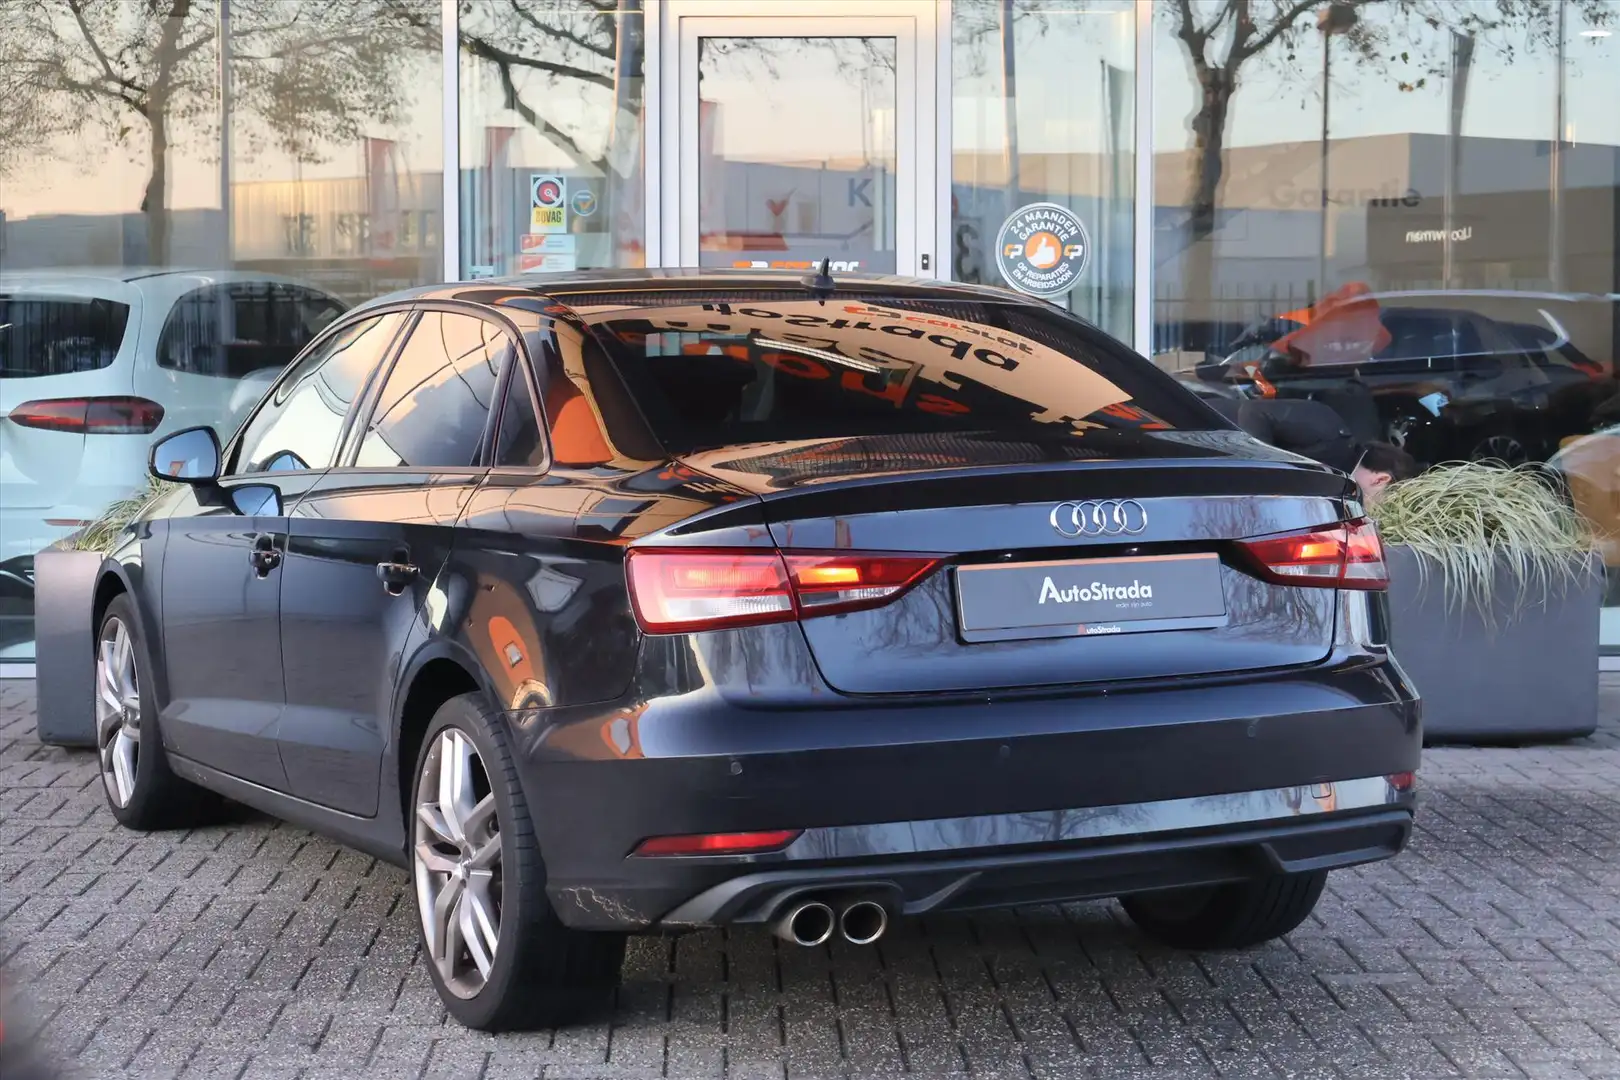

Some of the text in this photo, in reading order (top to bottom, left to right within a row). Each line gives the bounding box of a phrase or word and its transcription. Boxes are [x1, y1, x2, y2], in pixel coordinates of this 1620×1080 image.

[534, 210, 562, 223] BOVAG
[1010, 210, 1078, 236] 24 MAANDEN
[1018, 221, 1070, 242] GARANTIE
[1012, 268, 1074, 289] EN ARBEIDSLOON
[1017, 261, 1070, 281] OP REPARATIES
[1038, 576, 1153, 604] AutoStrada
